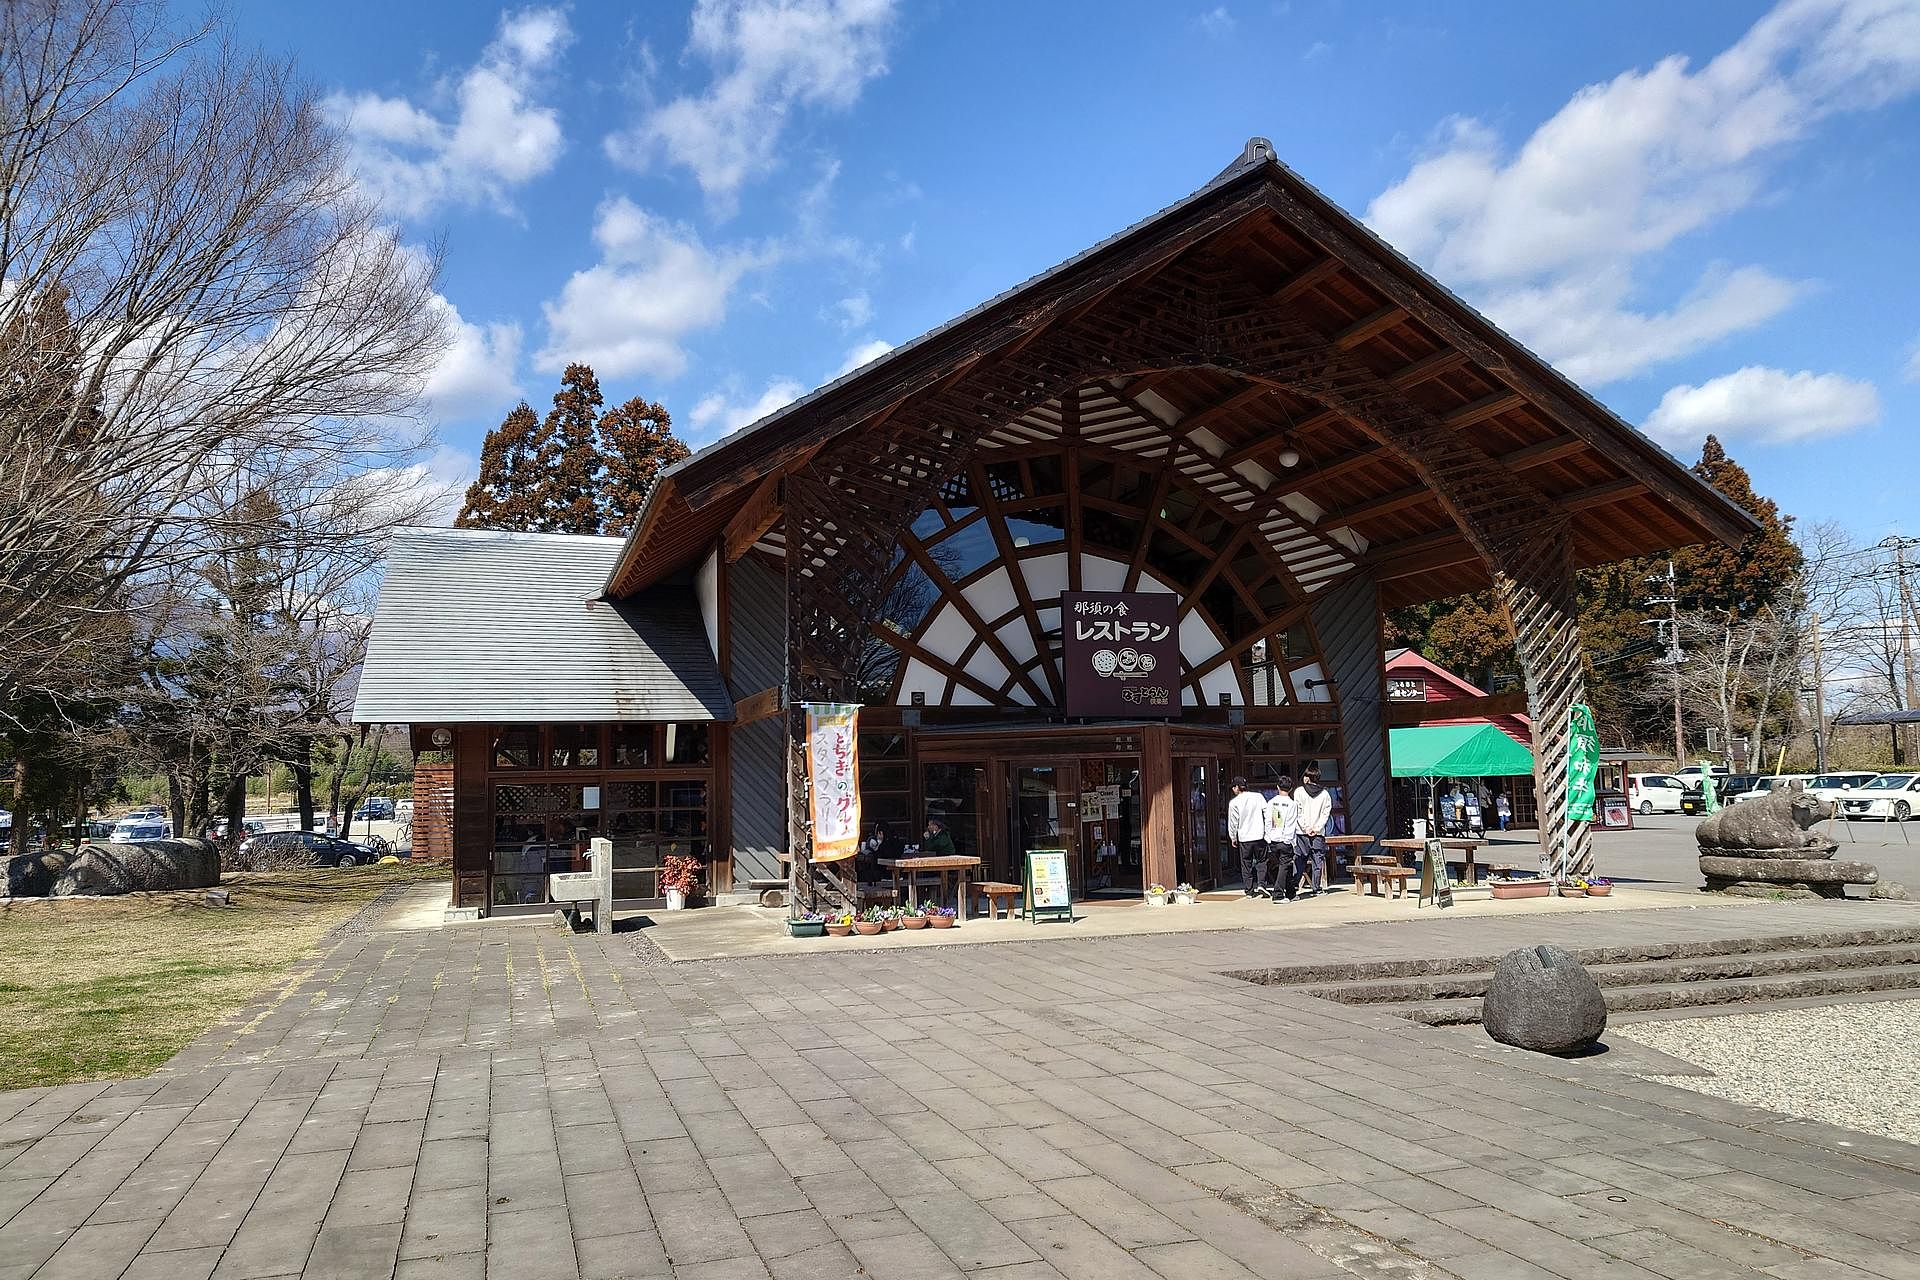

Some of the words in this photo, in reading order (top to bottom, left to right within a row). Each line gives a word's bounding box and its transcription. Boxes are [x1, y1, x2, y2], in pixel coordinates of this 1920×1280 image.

[1074, 602, 1129, 616] 那須の食
[1076, 621, 1170, 641] レストラン
